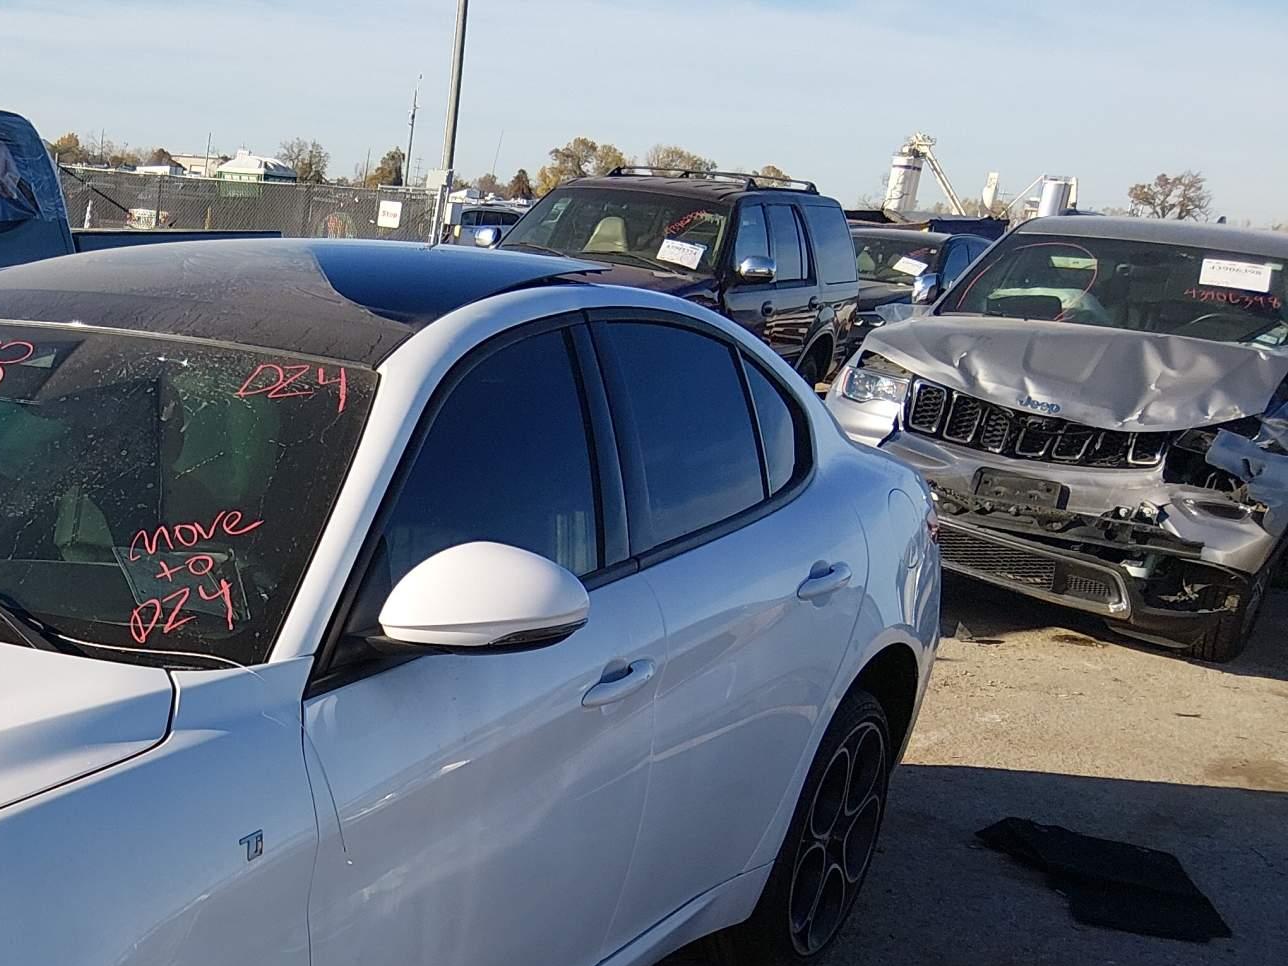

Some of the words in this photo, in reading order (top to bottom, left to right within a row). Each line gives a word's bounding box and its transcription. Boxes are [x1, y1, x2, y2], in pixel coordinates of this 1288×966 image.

[233, 363, 347, 413] DZ4
[1017, 395, 1061, 414] Jeep
[130, 578, 234, 643] DZ4
